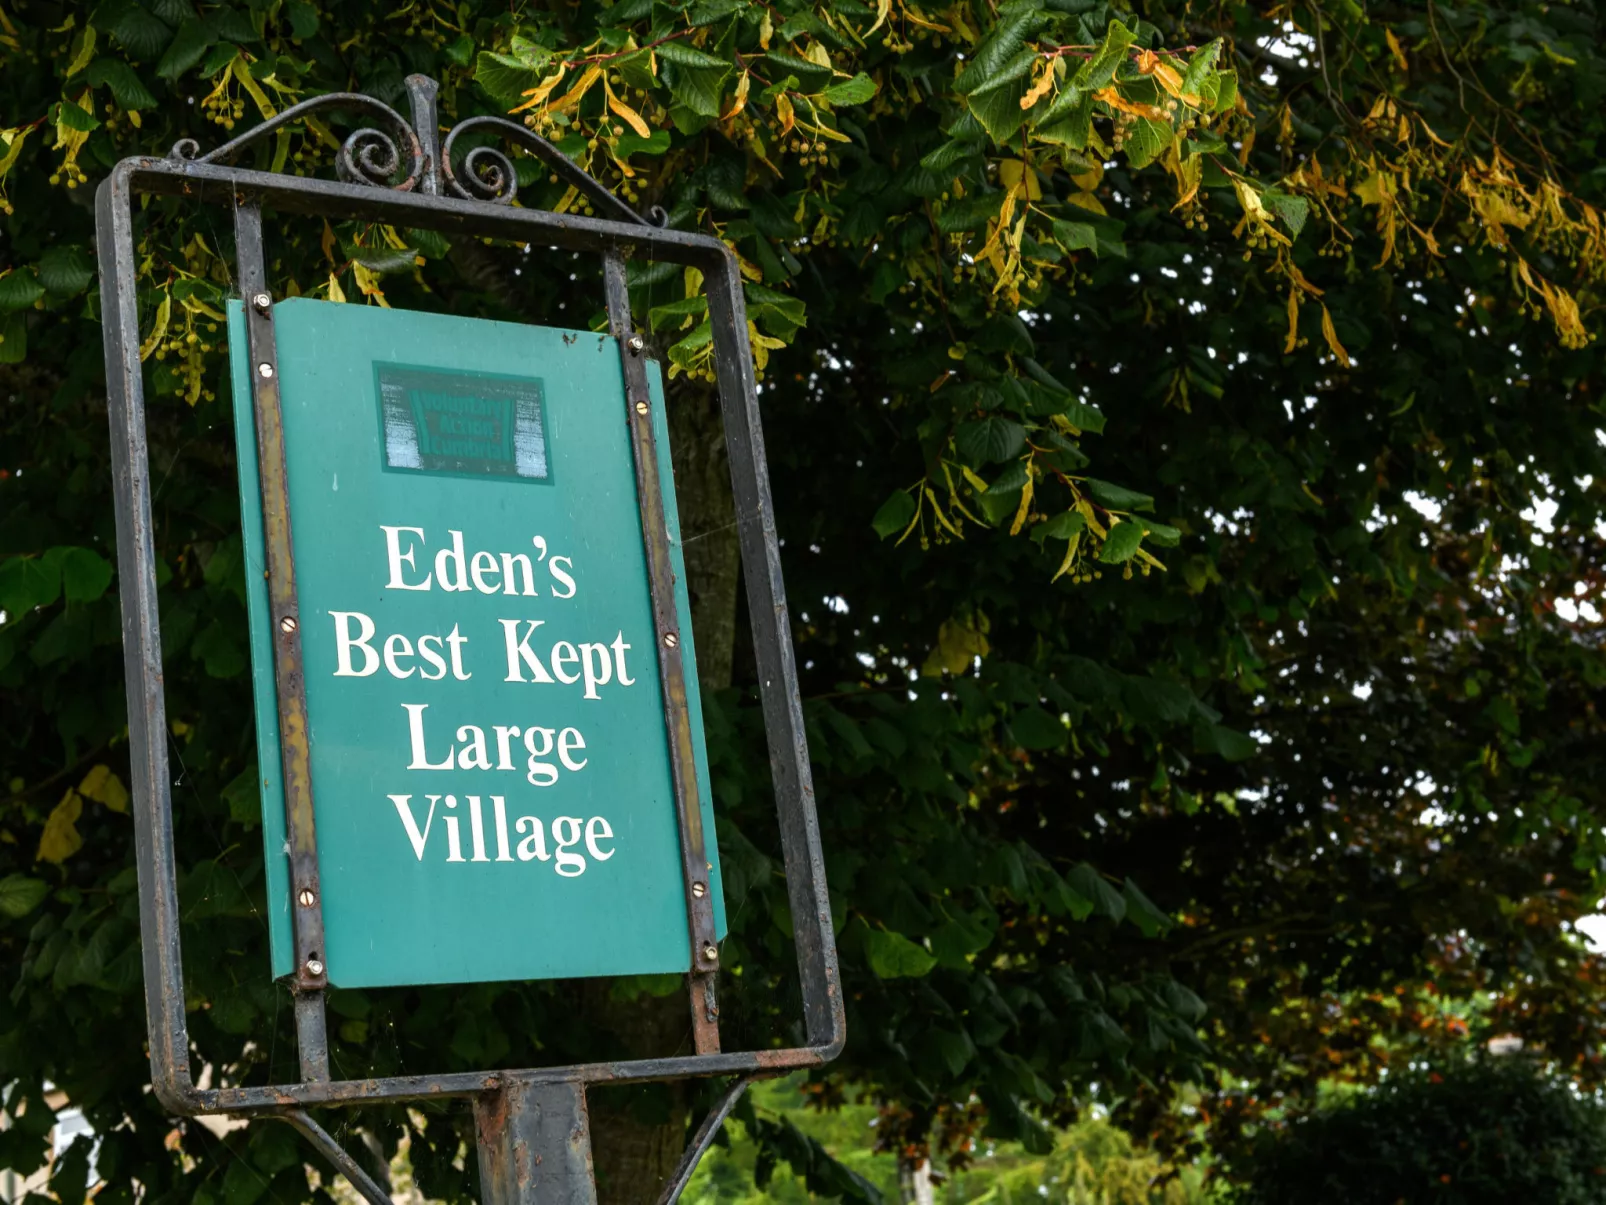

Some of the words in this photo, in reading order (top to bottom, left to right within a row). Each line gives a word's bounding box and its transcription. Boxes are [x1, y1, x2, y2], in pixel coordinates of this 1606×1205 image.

[379, 524, 577, 599] Eden's
[327, 610, 473, 681] Best
[497, 618, 636, 700] Kept
[400, 703, 588, 787] Large
[386, 793, 616, 878] Village
